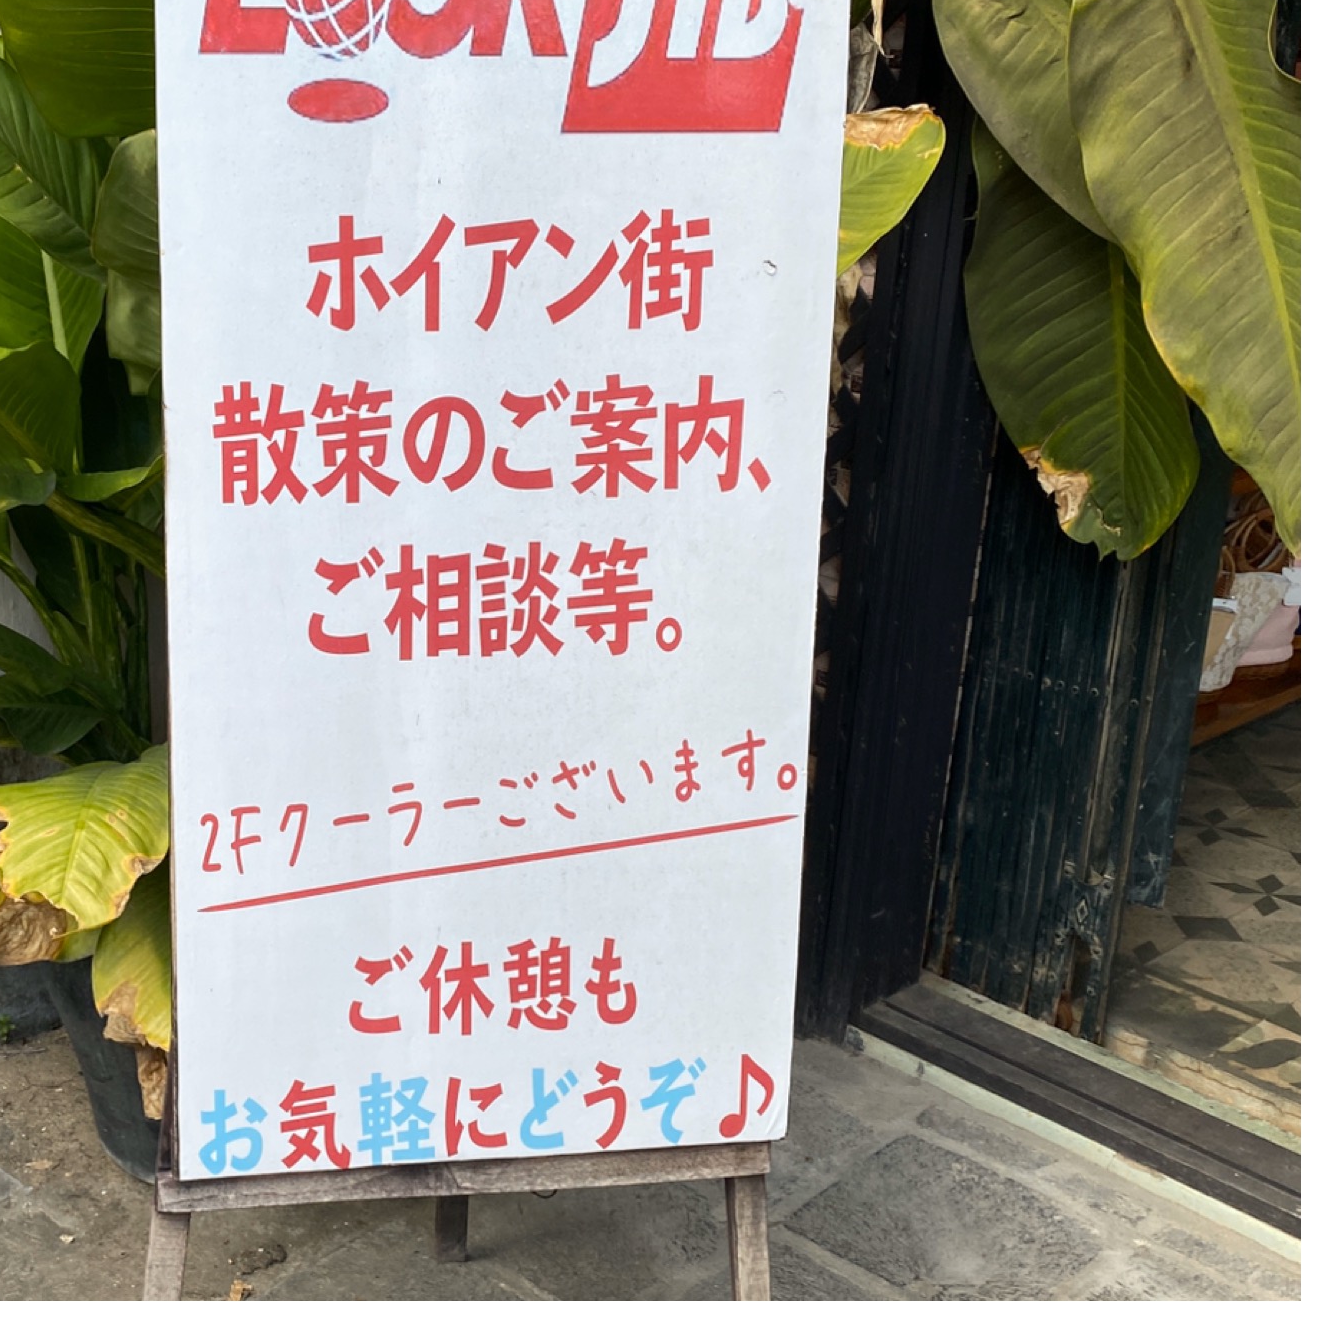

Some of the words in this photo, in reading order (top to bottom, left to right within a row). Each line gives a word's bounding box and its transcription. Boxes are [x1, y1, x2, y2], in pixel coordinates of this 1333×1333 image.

[307, 209, 713, 331] ホイアン街
[213, 375, 770, 505] 散策のご案内、
[309, 539, 681, 660] ご相談等。
[349, 937, 636, 1035] ご休憩も
